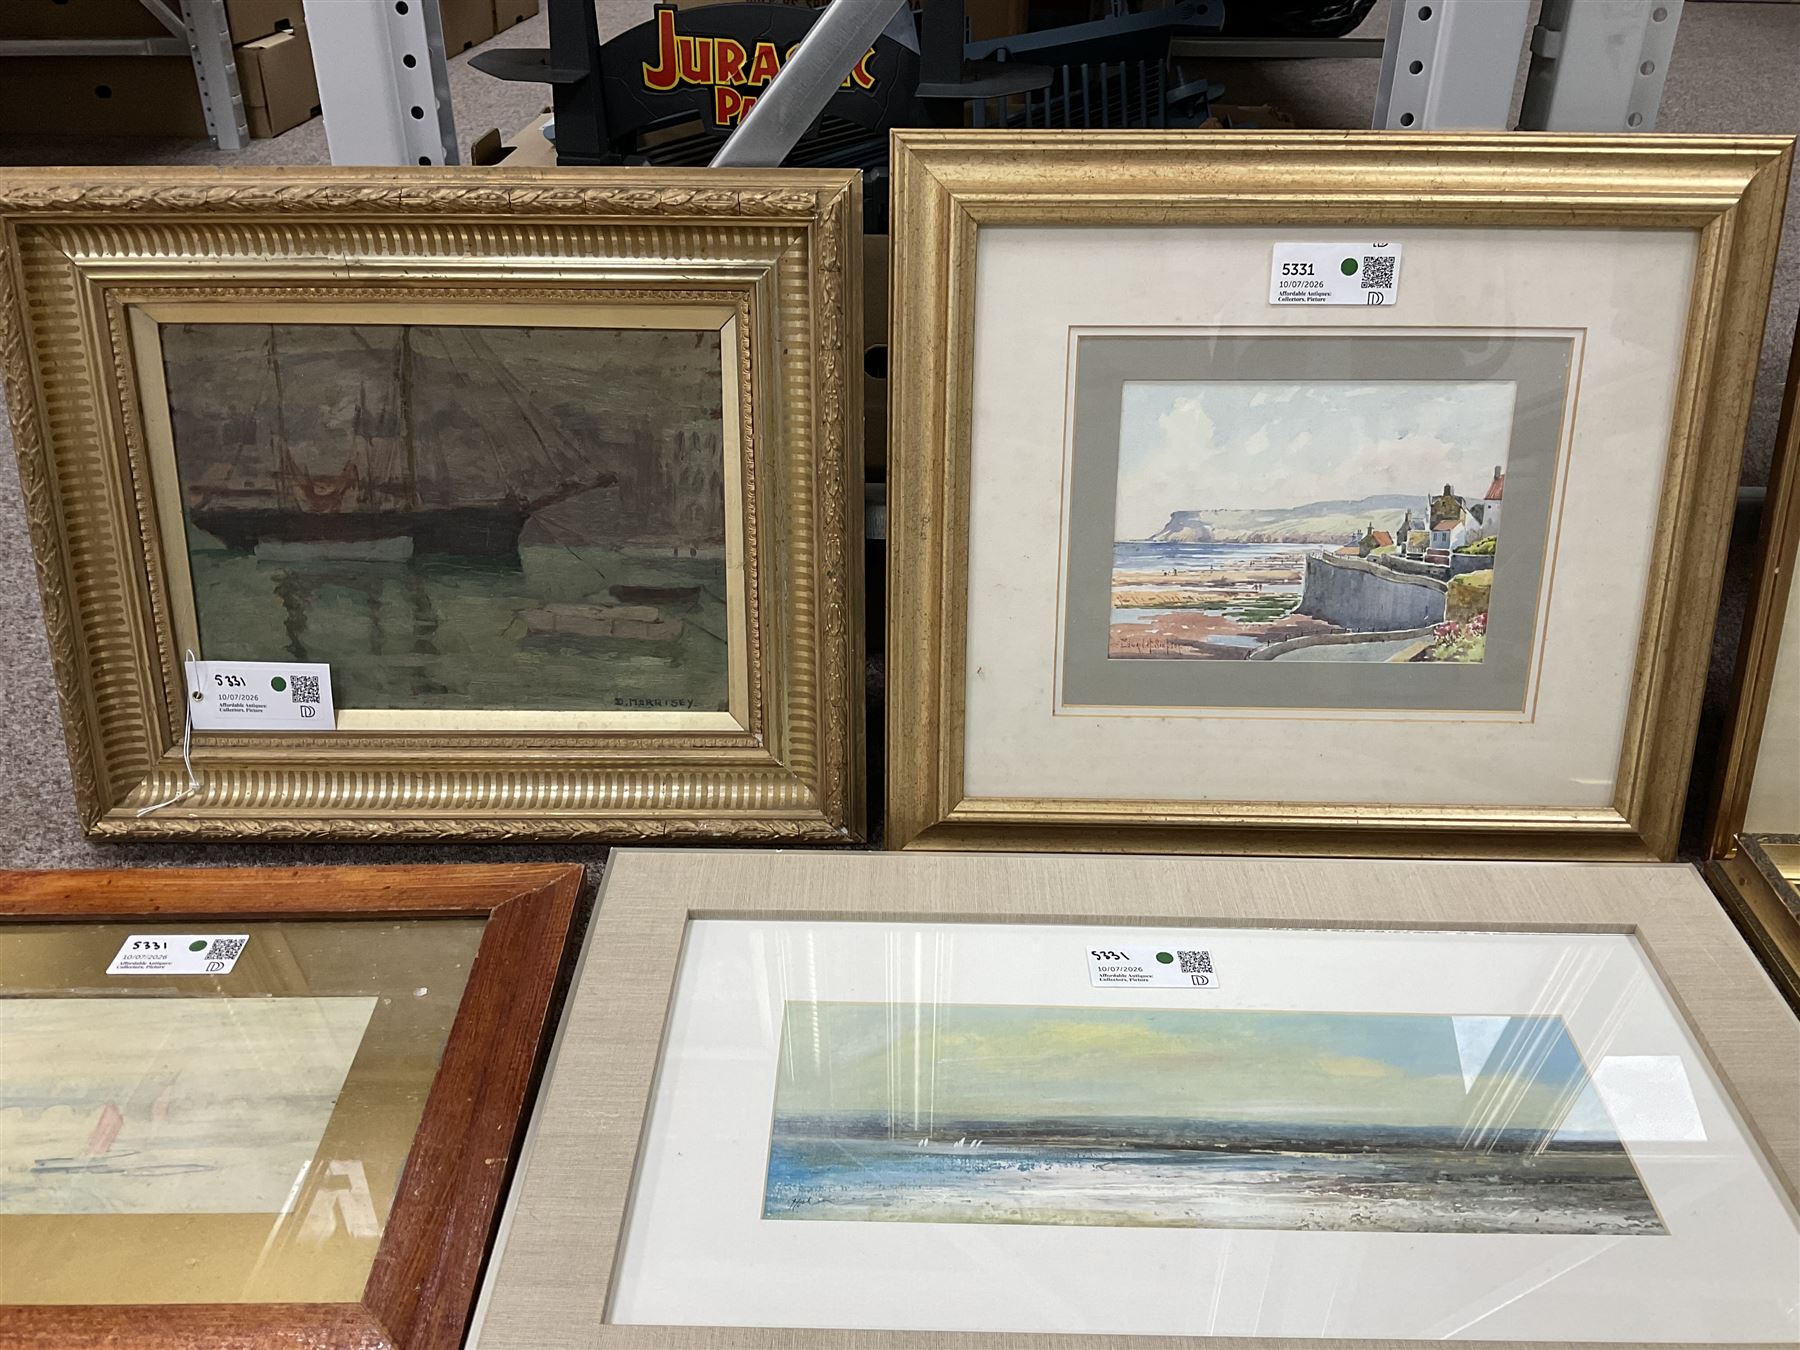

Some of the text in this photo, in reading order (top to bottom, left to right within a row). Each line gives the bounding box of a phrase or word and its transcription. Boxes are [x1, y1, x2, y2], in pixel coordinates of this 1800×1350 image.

[1282, 263, 1315, 276] 5331
[214, 674, 246, 687] 5331
[132, 941, 167, 950] 5331
[1091, 950, 1130, 961] 5331
